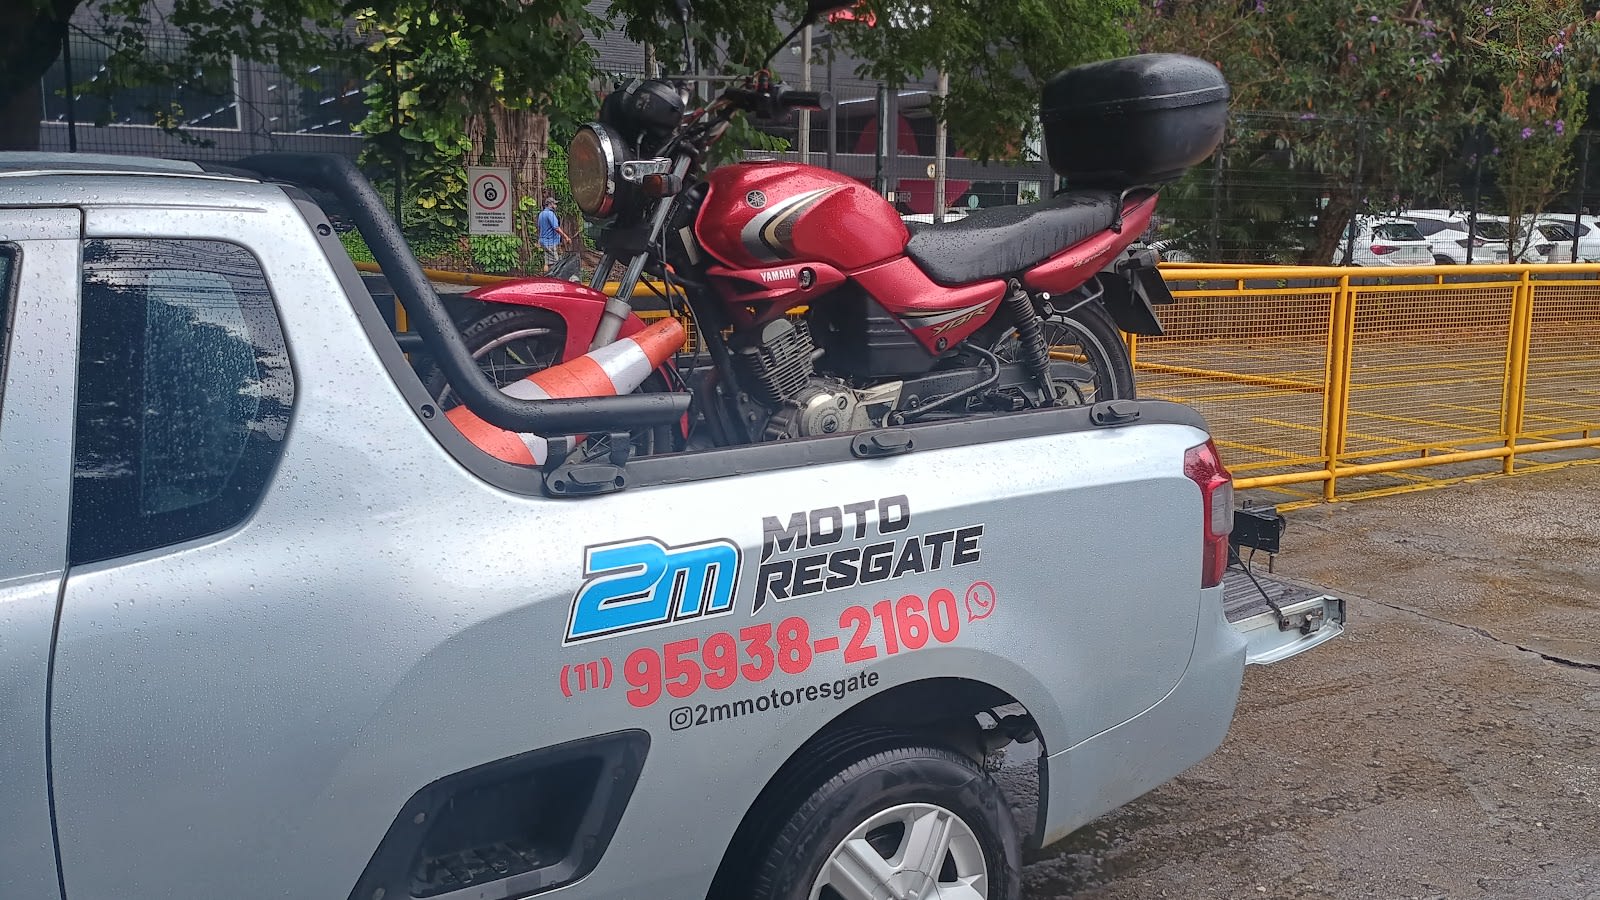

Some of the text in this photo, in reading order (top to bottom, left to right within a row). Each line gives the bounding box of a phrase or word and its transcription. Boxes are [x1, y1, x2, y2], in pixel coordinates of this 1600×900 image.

[760, 268, 796, 283] YAMAHA
[761, 494, 911, 564] MOTO
[751, 523, 985, 616] RESGATE
[559, 588, 960, 708] (11) 95938-2160
[695, 669, 880, 727] 2mmotoresgate
